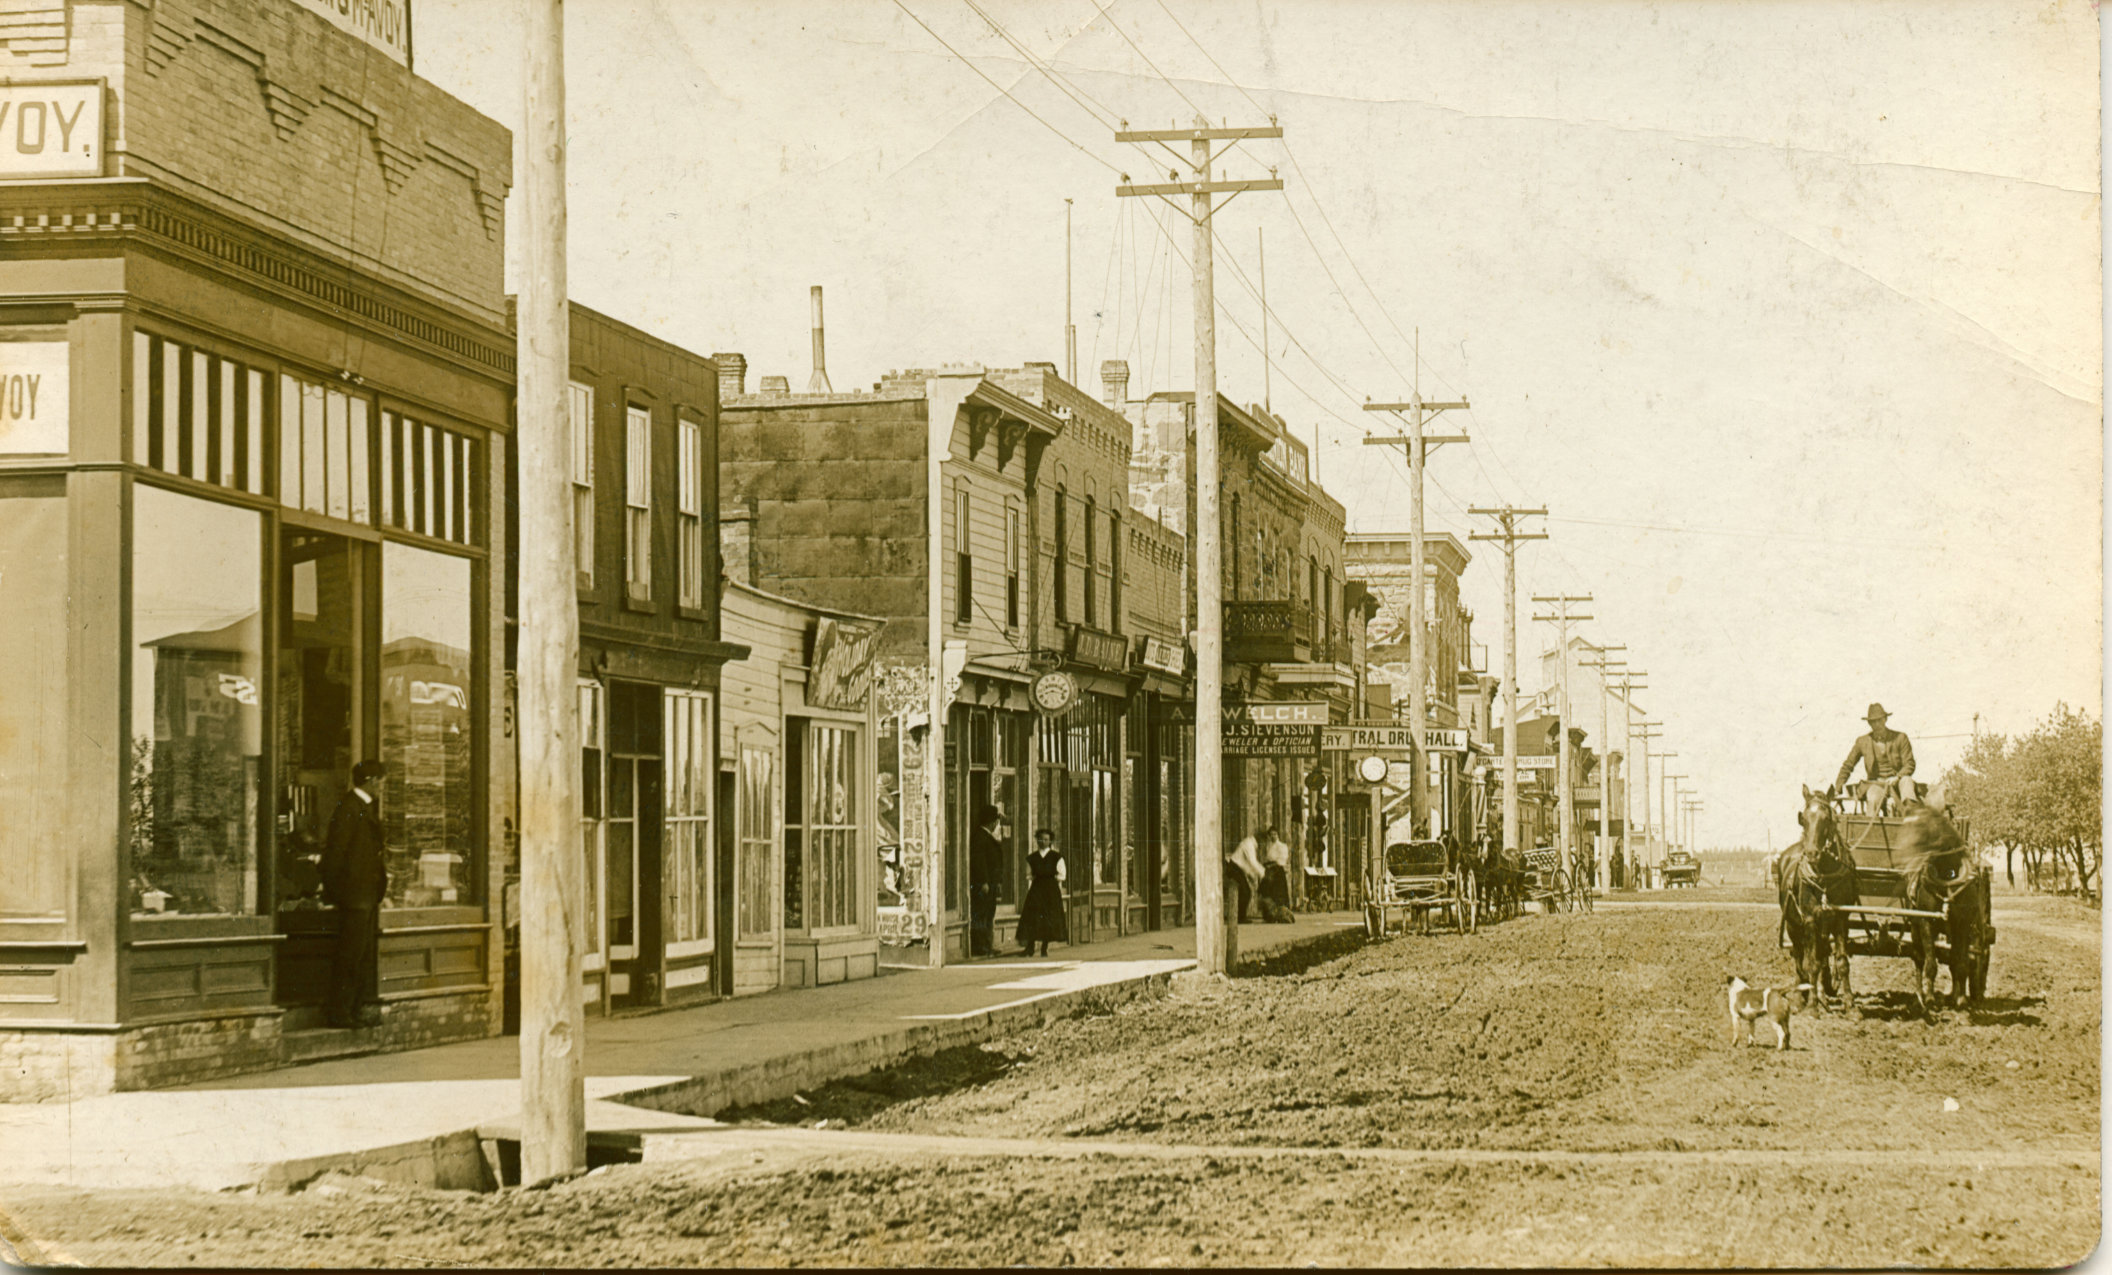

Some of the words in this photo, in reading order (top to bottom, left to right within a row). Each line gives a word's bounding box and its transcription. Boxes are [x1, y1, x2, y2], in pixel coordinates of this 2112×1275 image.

[1221, 737, 1258, 746] EWELER
[1262, 737, 1268, 746] &
[1273, 736, 1312, 746] OPTICIAN
[1389, 730, 1411, 746] DRU
[1221, 746, 1248, 755] RRIAGE
[1252, 746, 1287, 754] LICENSES
[1290, 746, 1316, 754] ISSUED
[901, 914, 927, 935] 29
